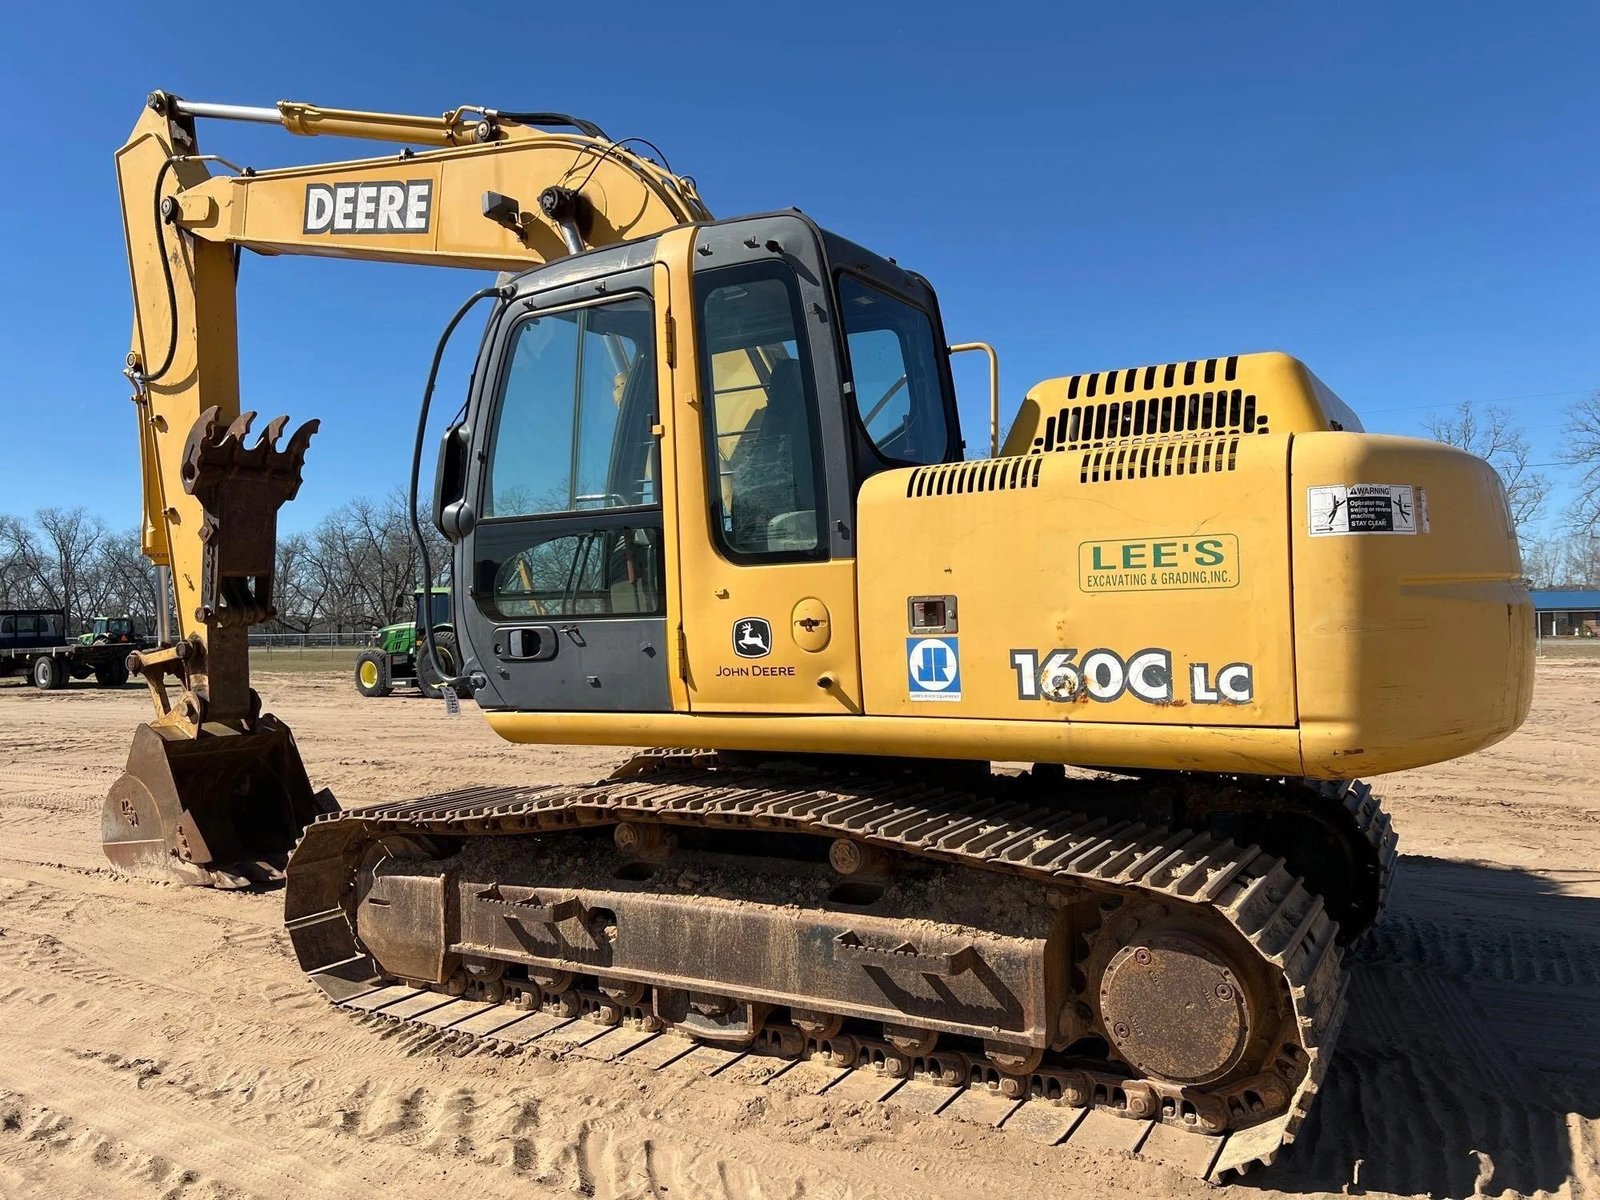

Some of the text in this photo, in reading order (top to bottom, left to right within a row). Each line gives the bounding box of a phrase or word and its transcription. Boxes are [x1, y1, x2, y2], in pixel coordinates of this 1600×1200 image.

[304, 181, 431, 232] DEERE
[1357, 487, 1389, 495] WARNING
[1092, 539, 1224, 570] LEE'S
[1087, 573, 1147, 587] EXCAVATING
[1150, 574, 1158, 585] &
[715, 665, 796, 677] JOHN DEERE
[1011, 648, 1252, 704] 160C LC
